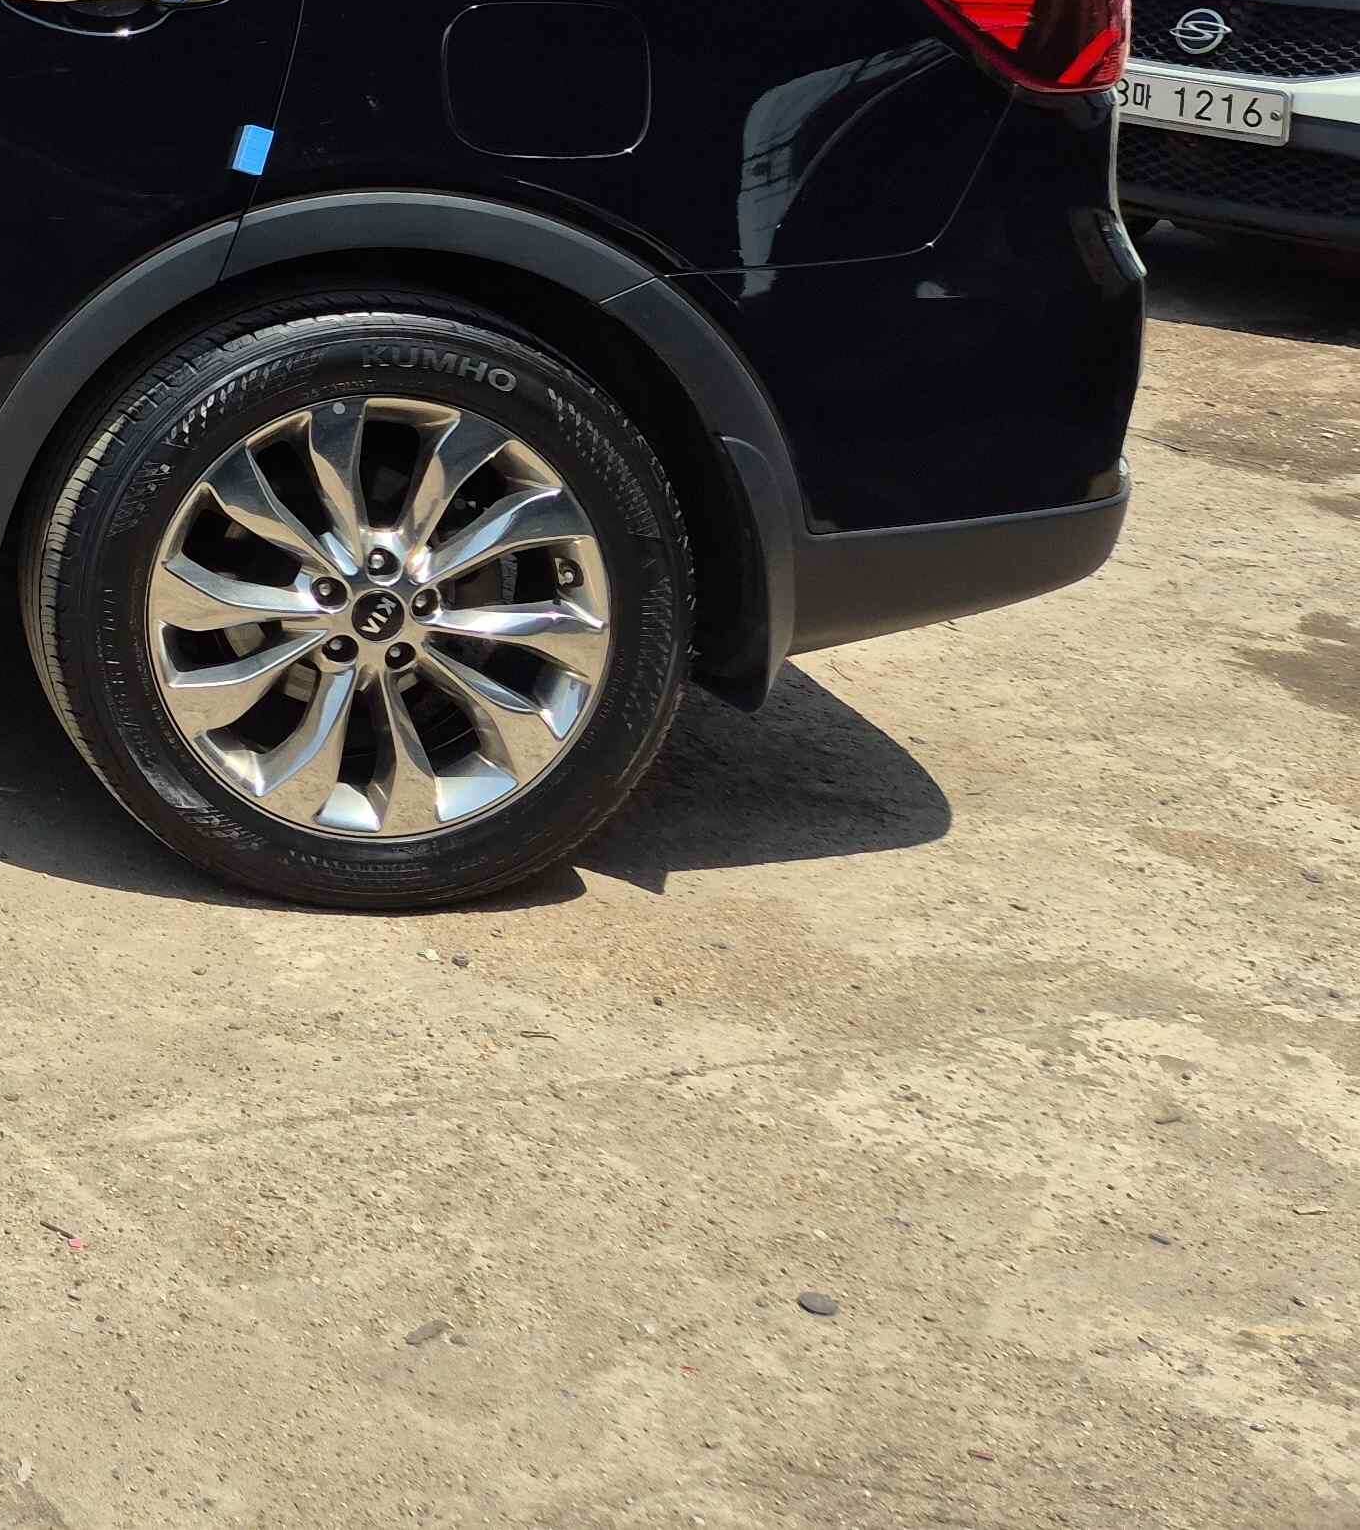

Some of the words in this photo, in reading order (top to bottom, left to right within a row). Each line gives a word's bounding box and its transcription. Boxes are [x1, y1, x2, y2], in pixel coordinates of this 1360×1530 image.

[1174, 86, 1263, 128] 1216
[360, 343, 518, 392] KUMHO
[360, 596, 397, 633] KIA
